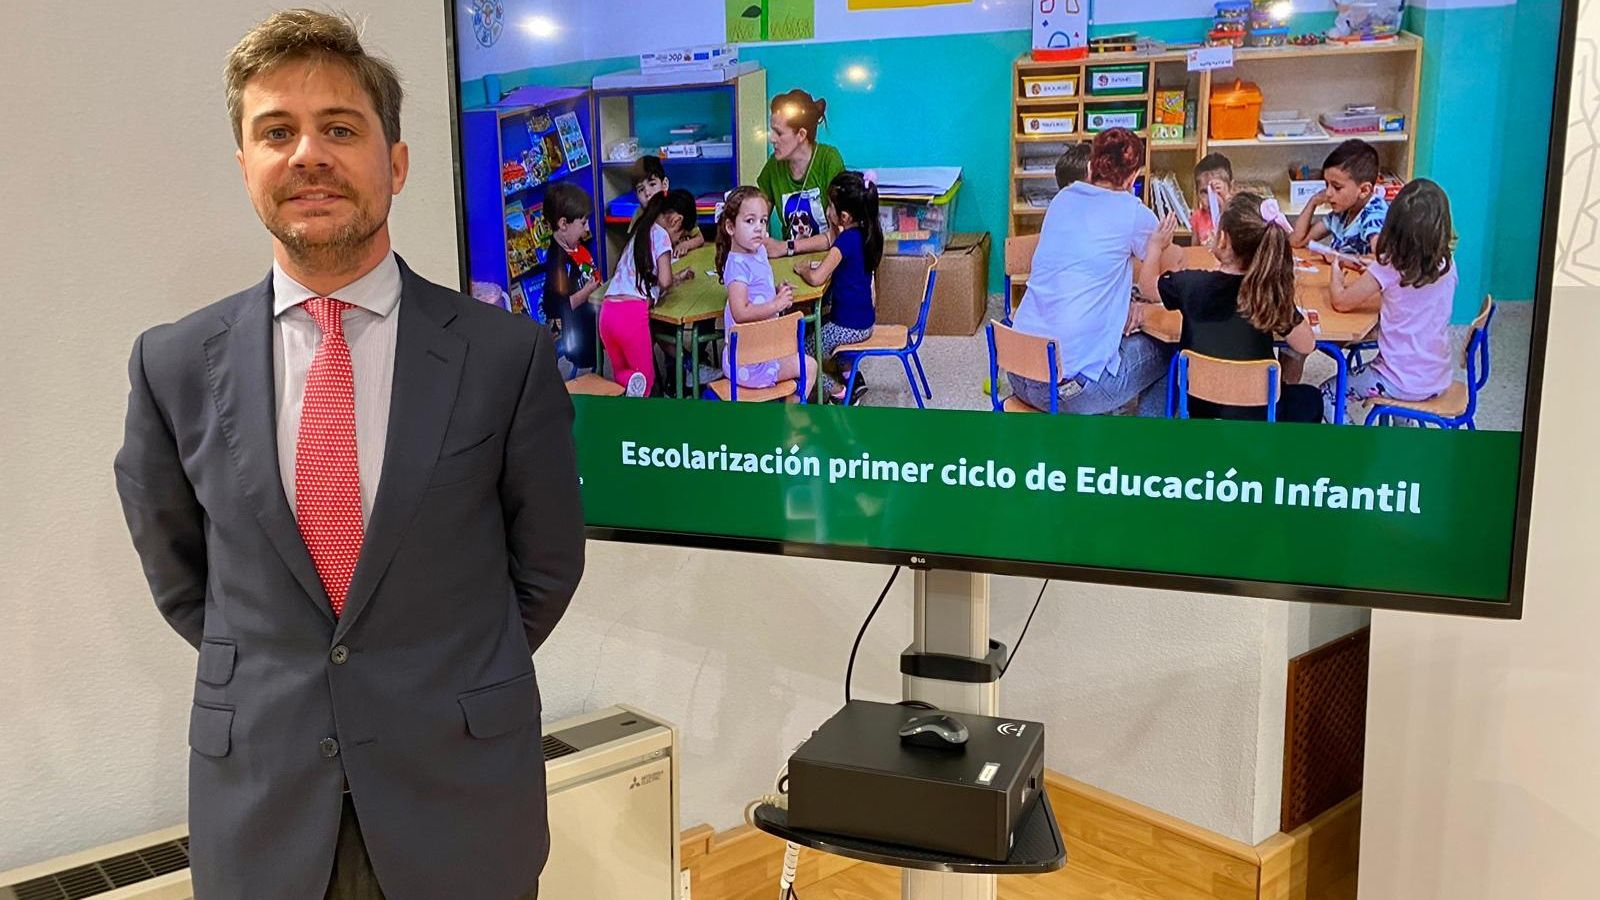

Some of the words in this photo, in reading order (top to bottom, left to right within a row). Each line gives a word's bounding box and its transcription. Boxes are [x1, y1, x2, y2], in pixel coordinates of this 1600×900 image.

[621, 438, 819, 477] Escolarización
[829, 452, 934, 484] primer
[941, 457, 1016, 489] ciclo
[1025, 462, 1067, 492] de
[1077, 465, 1263, 504] Educación
[1274, 477, 1421, 514] Infantil
